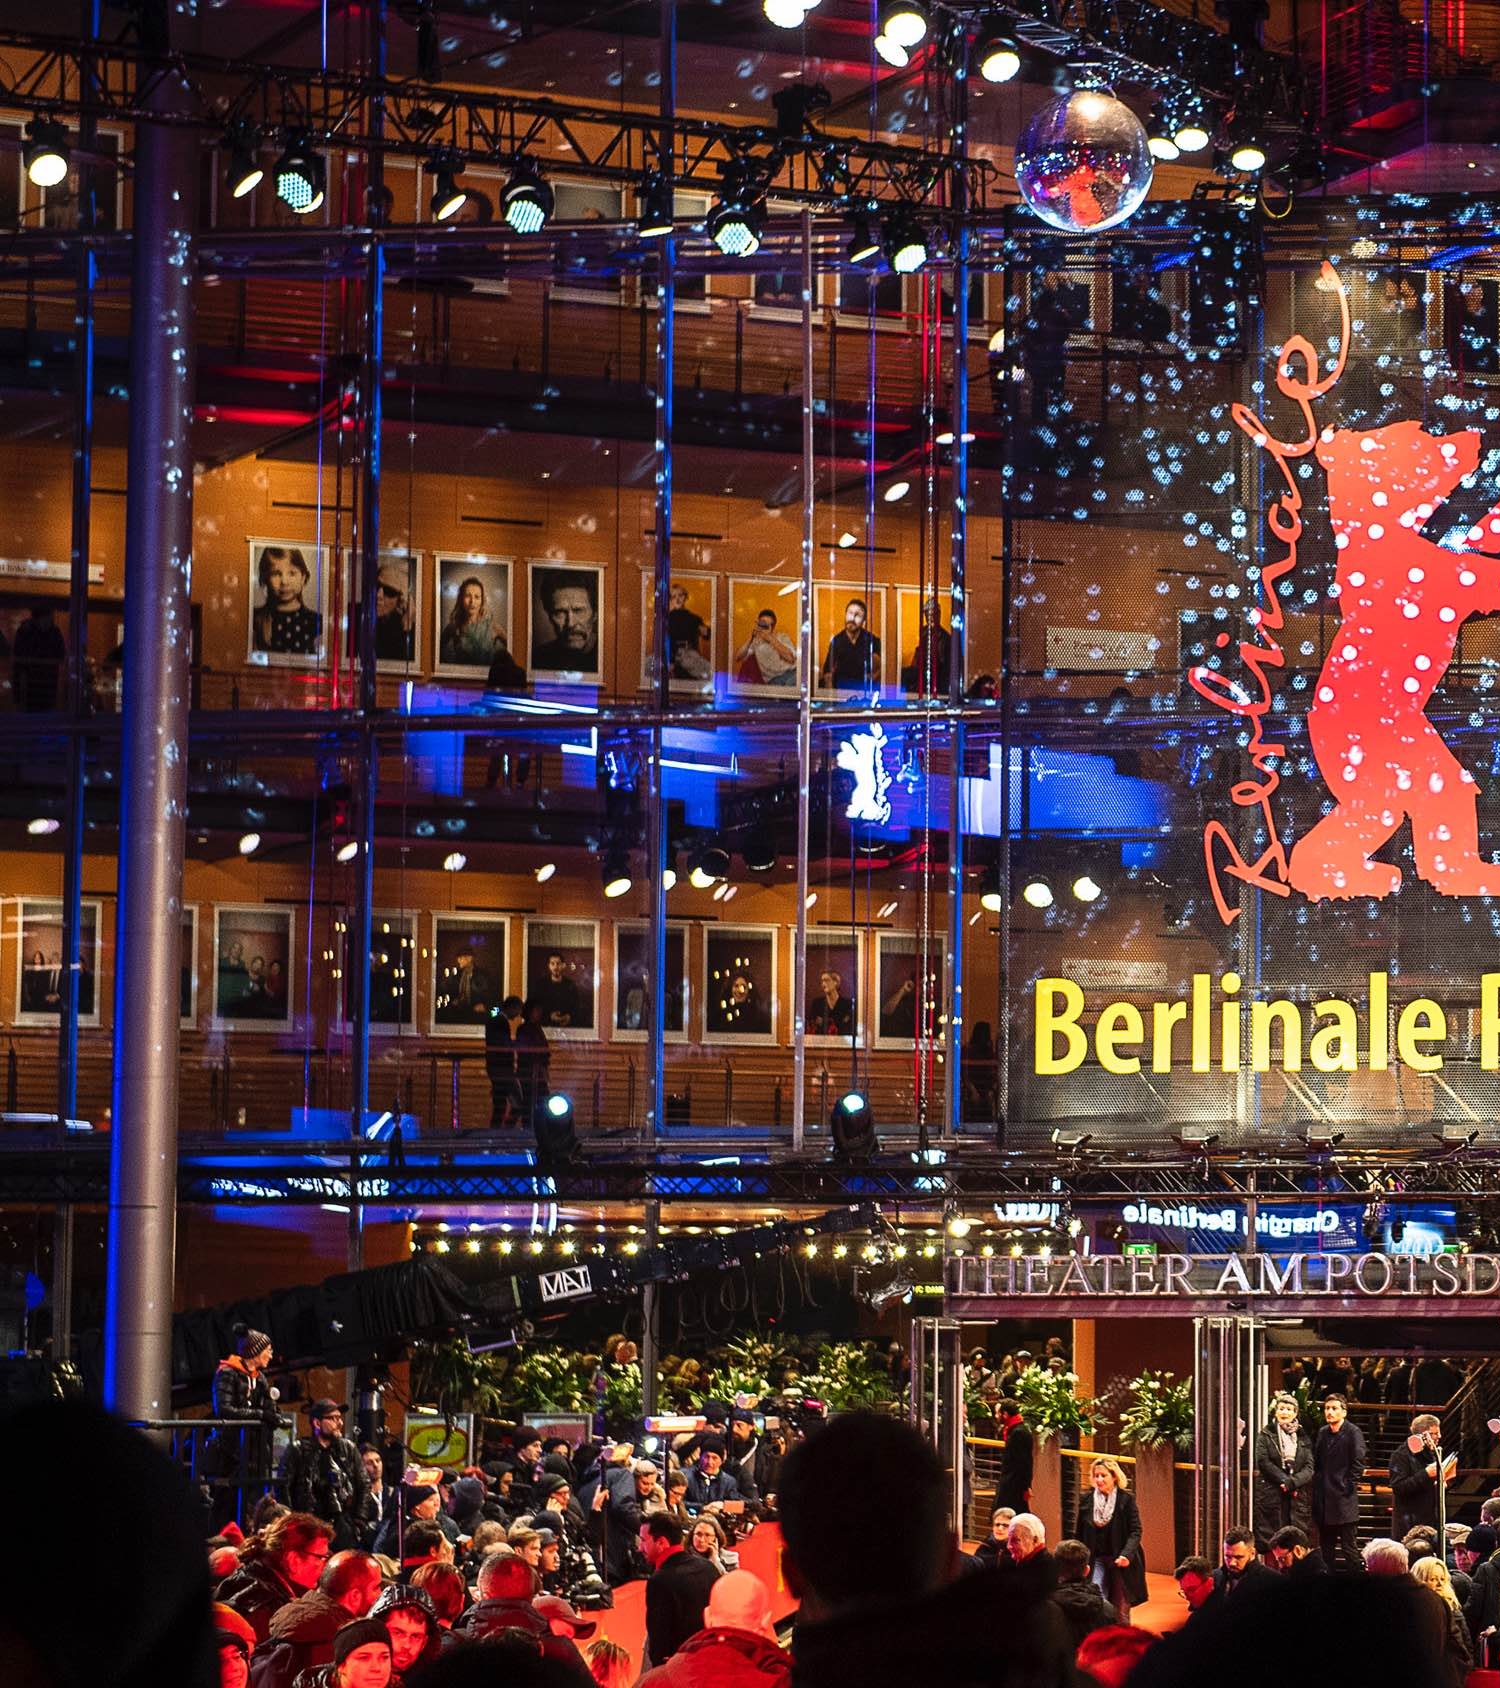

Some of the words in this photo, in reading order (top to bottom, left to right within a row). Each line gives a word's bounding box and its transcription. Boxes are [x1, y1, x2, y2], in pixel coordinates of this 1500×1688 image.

[1188, 259, 1350, 925] Berlinale
[1034, 971, 1447, 1075] Berlinale
[946, 1253, 1208, 1297] THEATER
[1215, 1252, 1307, 1297] AM
